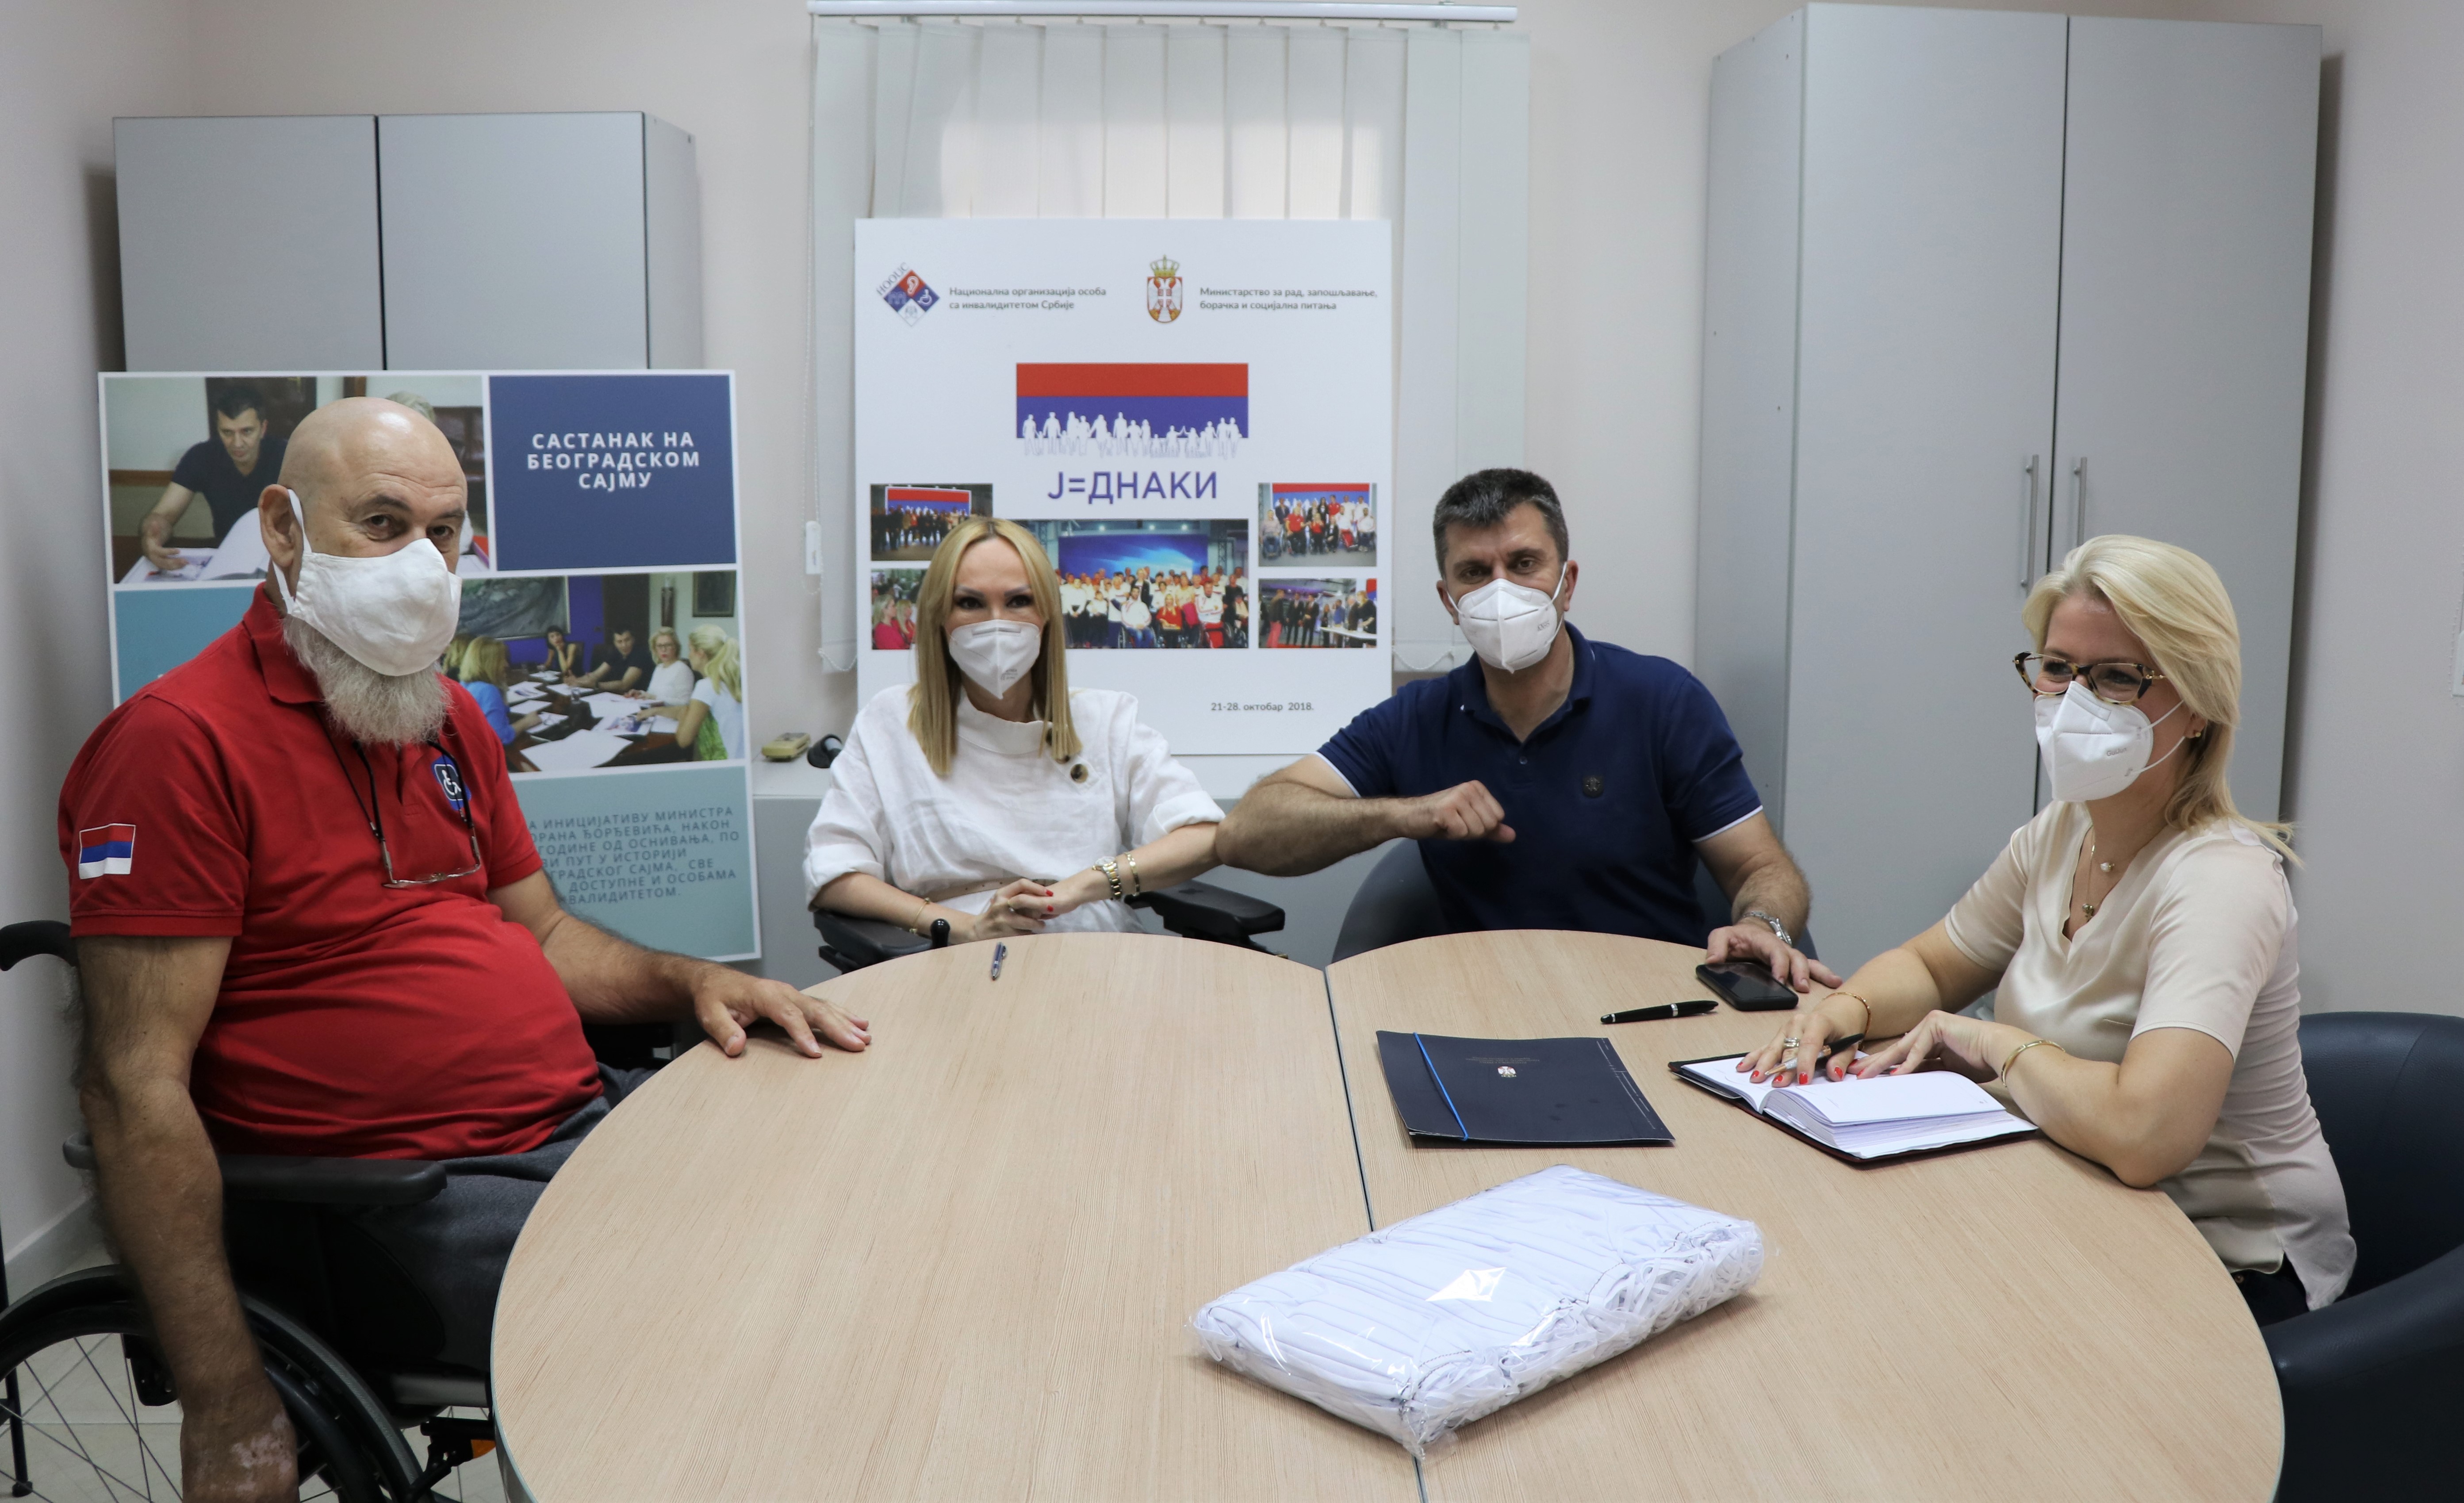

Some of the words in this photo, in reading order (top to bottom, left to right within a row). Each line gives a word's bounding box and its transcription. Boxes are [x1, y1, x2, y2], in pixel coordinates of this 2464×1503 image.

[950, 287, 1009, 297] Национална
[1012, 287, 1076, 297] организација
[1078, 287, 1107, 296] особа
[1200, 288, 1270, 298] Министарство
[962, 302, 1038, 311] инвалидитетом
[1041, 300, 1075, 311] Србије
[1200, 300, 1239, 311] борачка
[1250, 301, 1298, 311] социјална
[532, 432, 655, 450] САСТАНАК
[664, 432, 694, 447] НА
[527, 451, 700, 471] БЕОГРАДСКОМ
[579, 472, 652, 492] САЈМУ
[1047, 471, 1217, 505] Ј=ДНАКИ
[1211, 702, 1241, 711] 21-28.
[1243, 702, 1283, 712] октобар
[1288, 702, 1314, 711] 2018.
[544, 812, 649, 829] ИНИЦИЈАТИВУ
[655, 807, 733, 821] МИНИСТРА
[531, 831, 576, 842] ОРАНА
[682, 820, 729, 832] НАКОН
[538, 842, 596, 856] ГОДИНЕ
[603, 840, 623, 851] ОД
[720, 832, 740, 842] ПО
[566, 855, 592, 866] ПУТ
[598, 855, 607, 864] У
[613, 848, 686, 863] ИСТОРИЈИ
[550, 866, 623, 879] ГРАДСКОГ
[688, 859, 714, 870] СВЕ
[569, 876, 645, 893] ДОСТУПНЕ
[652, 875, 661, 885] И
[667, 869, 736, 884] ОСОБАМА
[565, 887, 680, 905] ВАЛИДИТЕТОМ.
